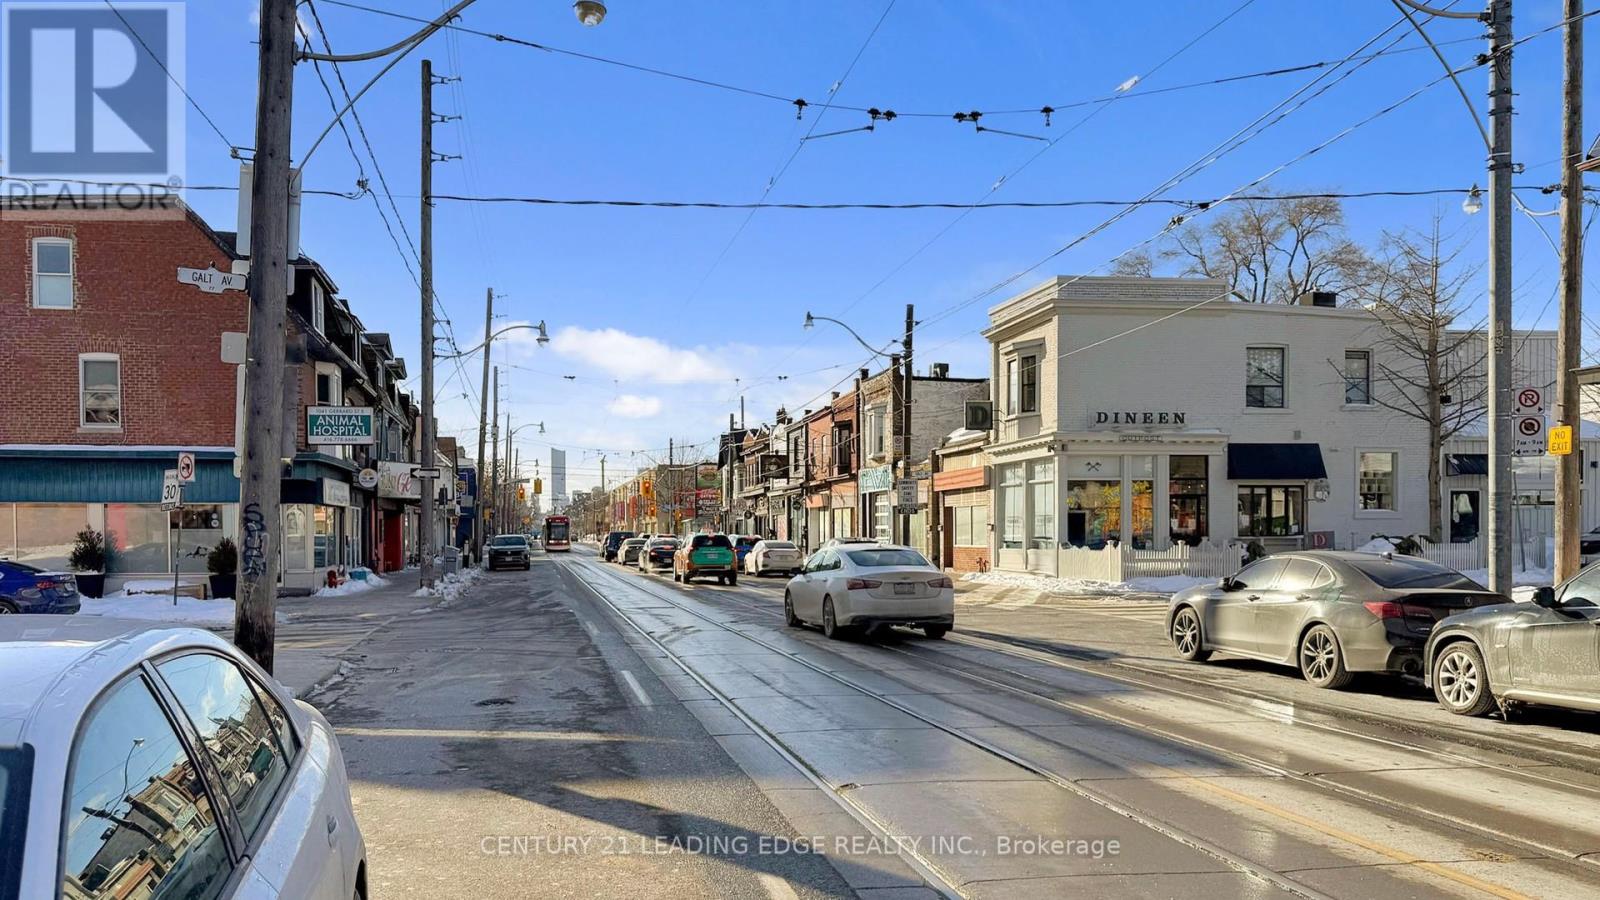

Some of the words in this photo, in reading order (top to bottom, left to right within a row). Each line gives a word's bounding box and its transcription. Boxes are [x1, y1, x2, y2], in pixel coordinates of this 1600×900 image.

[191, 271, 213, 284] GALT
[316, 415, 364, 426] ANIMAL
[968, 405, 988, 426] D
[1095, 411, 1186, 425] DINEEN
[313, 426, 368, 436] HOSPITAL
[1554, 430, 1566, 440] NO
[1551, 442, 1568, 451] EXIT
[164, 484, 176, 500] 30
[1313, 534, 1326, 546] D
